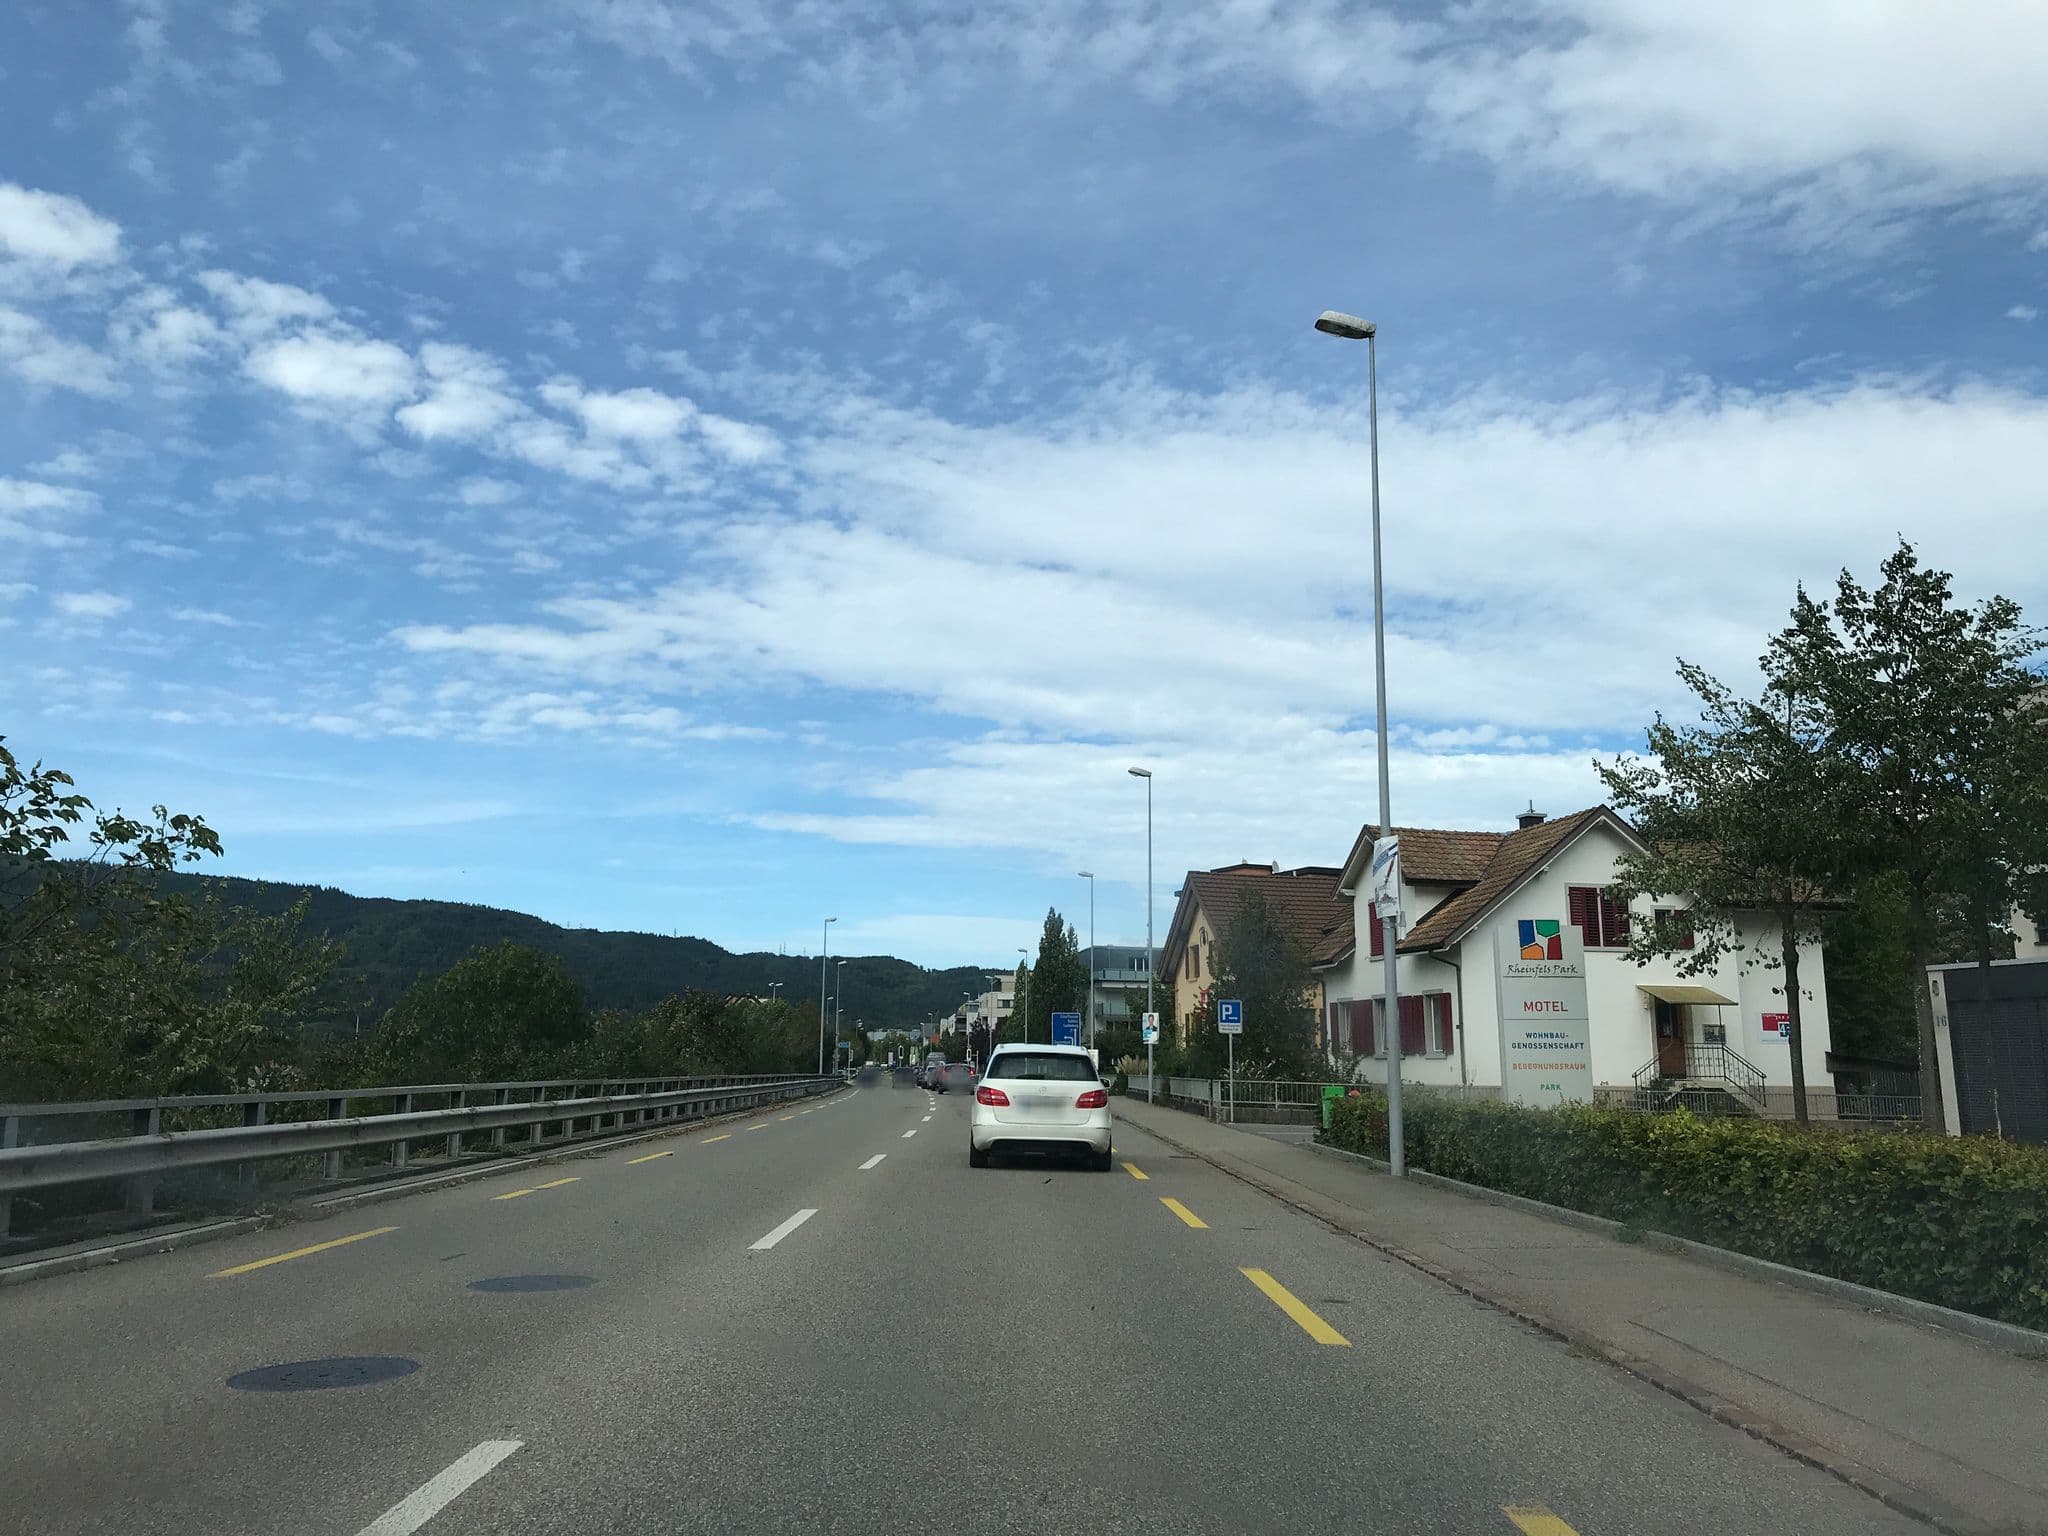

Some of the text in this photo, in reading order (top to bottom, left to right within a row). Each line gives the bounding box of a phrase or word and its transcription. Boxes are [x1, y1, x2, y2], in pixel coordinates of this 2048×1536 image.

[1507, 964, 1578, 978] Rheinfels Park
[1222, 1004, 1232, 1020] P
[1524, 1001, 1568, 1012] MOTEL
[1512, 1042, 1585, 1050] GENOSSENSCHAFT
[1540, 1083, 1561, 1091] PARK
